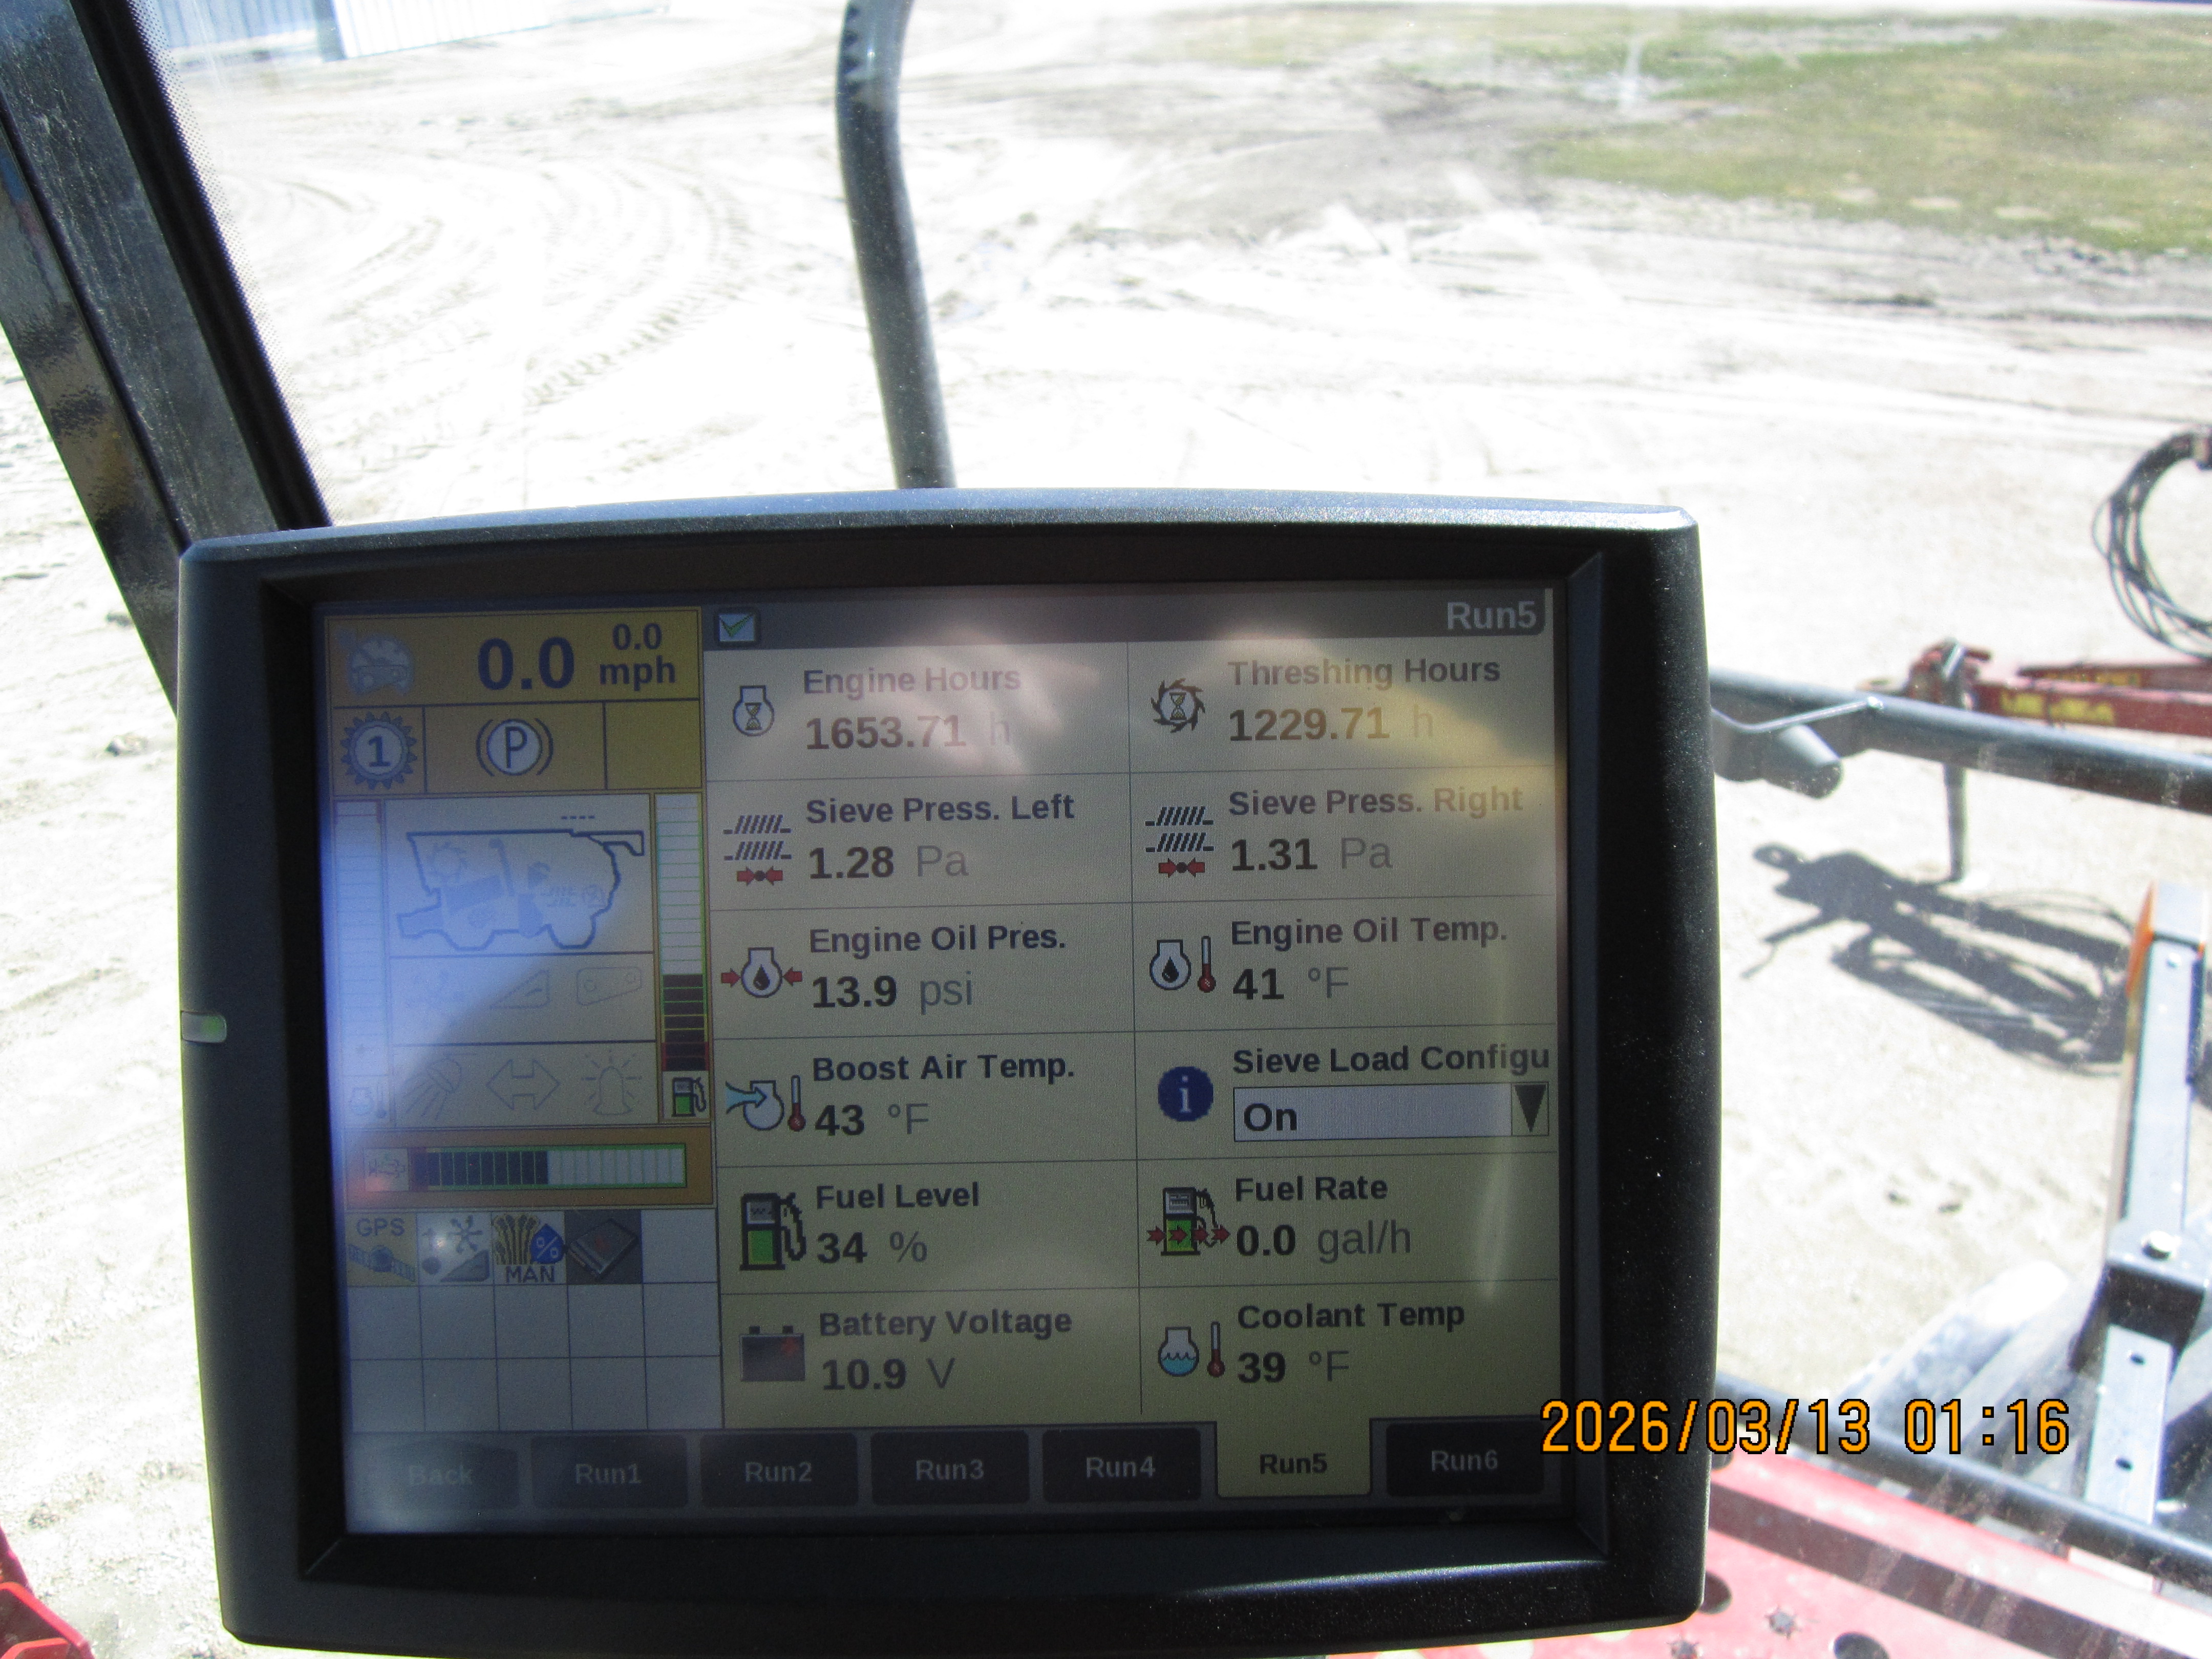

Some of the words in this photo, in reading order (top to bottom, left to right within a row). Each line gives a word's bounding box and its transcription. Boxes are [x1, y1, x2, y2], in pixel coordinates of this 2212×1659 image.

[1447, 600, 1537, 631] Run5
[612, 623, 662, 651] 0.0
[477, 636, 575, 691] 0.0
[599, 655, 676, 691] mph
[1228, 658, 1393, 691] Threshing
[1404, 658, 1501, 683] Hours
[803, 667, 916, 700] Engine
[925, 666, 1021, 692] Hours
[806, 714, 966, 750] 1653.71
[990, 711, 1010, 745] h
[1229, 706, 1390, 741] 1229.71
[1413, 704, 1434, 737] h
[368, 735, 391, 768] 1
[806, 798, 894, 823] Sieve
[904, 797, 999, 821] Press.
[1011, 793, 1074, 820] Left
[1229, 789, 1316, 816] Sieve
[1326, 789, 1422, 815] Press.
[1434, 785, 1523, 819] Right
[809, 846, 894, 879] 1.28
[917, 845, 969, 877] Pa
[1231, 837, 1318, 871] 1.31
[1341, 837, 1393, 869] Pa
[810, 927, 921, 960] Engine
[931, 925, 976, 950] Oil
[988, 925, 1066, 950] Pres.
[1231, 919, 1343, 952] Engine
[1353, 917, 1398, 943] Oil
[1410, 917, 1507, 947] Temp.
[812, 975, 897, 1009] 13.9
[921, 971, 973, 1015] psi
[1232, 968, 1285, 1001] 41
[813, 1055, 909, 1081] Boost
[922, 1054, 967, 1079] Air
[977, 1054, 1074, 1084] Temp.
[1233, 1048, 1321, 1074] Sieve
[1331, 1046, 1409, 1072] Load
[1421, 1044, 1549, 1076] Configu
[815, 1104, 864, 1137] 43
[1244, 1102, 1298, 1132] On
[817, 1183, 884, 1209] Fuel
[896, 1181, 979, 1208] Level
[1236, 1176, 1304, 1202] Fuel
[1315, 1175, 1388, 1201] Rate
[356, 1218, 405, 1238] GPS
[1237, 1224, 1295, 1257] 0.0
[1317, 1219, 1411, 1264] gal/h
[816, 1231, 867, 1264] 34
[889, 1231, 928, 1263] %
[505, 1266, 555, 1283] MAN
[820, 1312, 936, 1343] Battery
[946, 1308, 1072, 1341] Voltage
[1238, 1303, 1366, 1329] Coolant
[1377, 1302, 1465, 1332] Temp
[822, 1357, 907, 1391] 10.9
[926, 1358, 955, 1389] V
[1238, 1351, 1286, 1384] 39
[409, 1464, 474, 1486] Back
[575, 1463, 642, 1485] Run1
[745, 1461, 813, 1483] Run2
[916, 1459, 985, 1481] Run3
[1086, 1456, 1156, 1478] Run4
[1260, 1452, 1328, 1474] Run5
[1431, 1449, 1499, 1472] Run6
